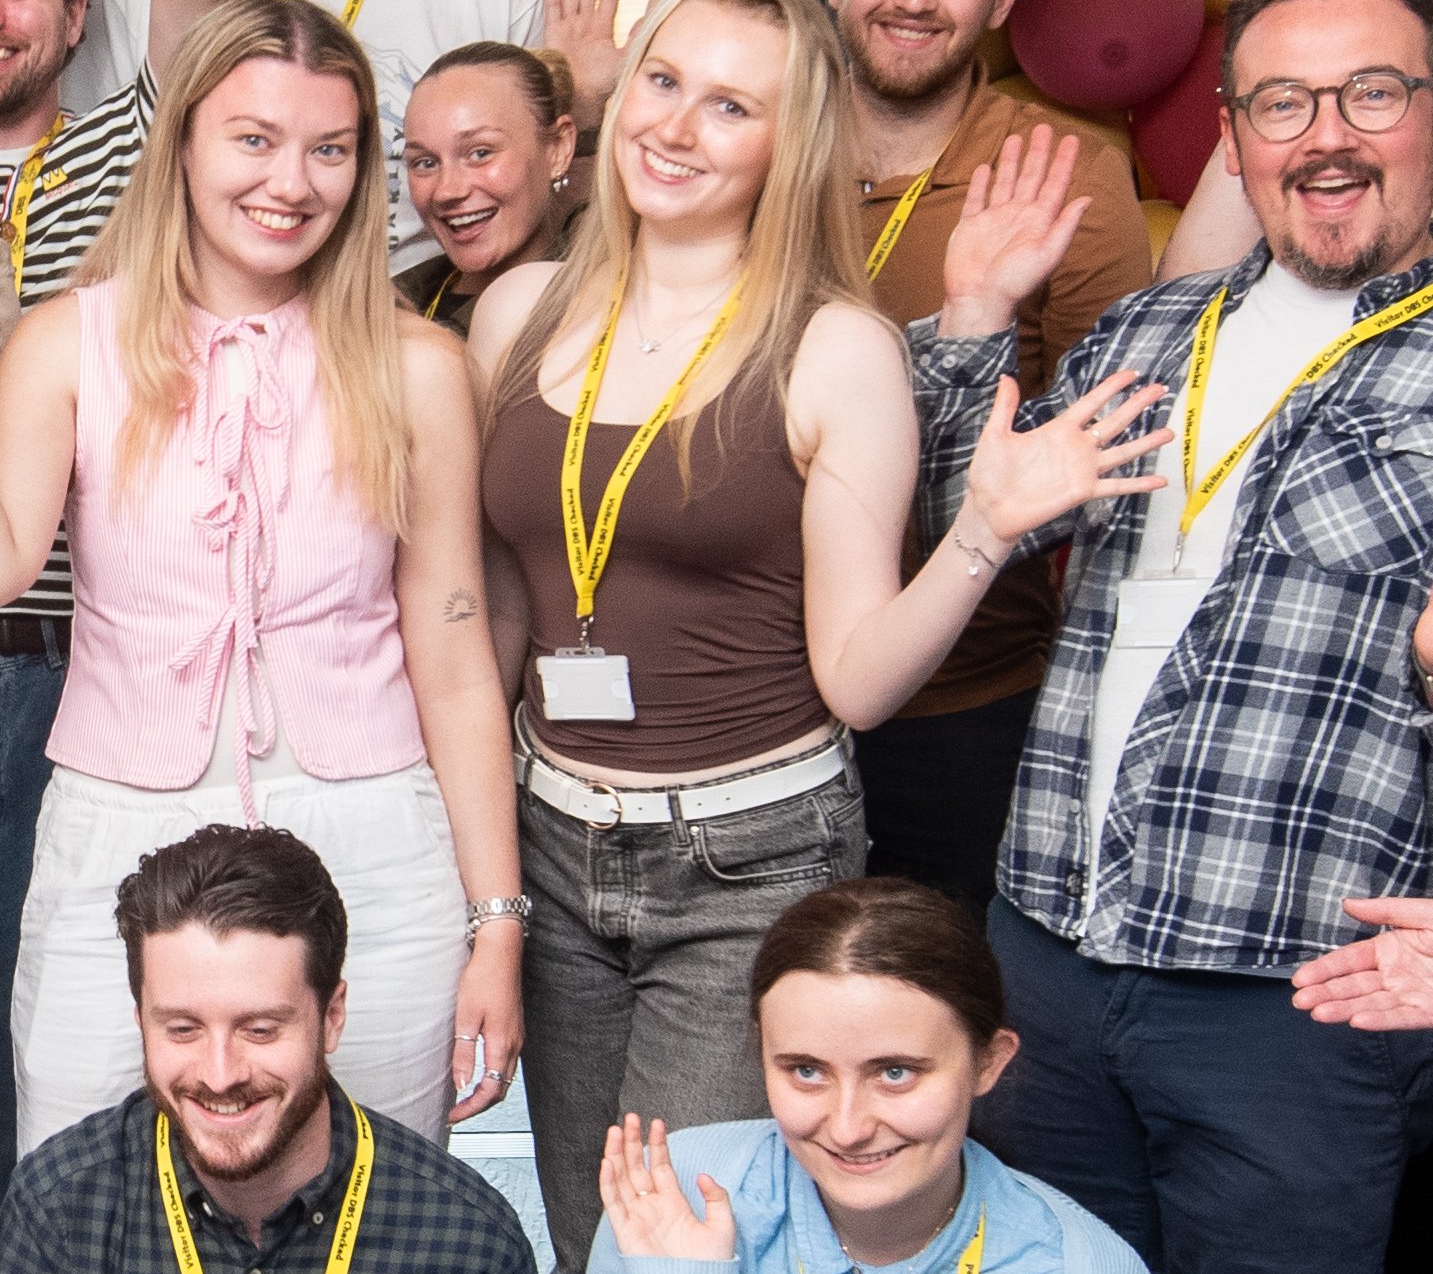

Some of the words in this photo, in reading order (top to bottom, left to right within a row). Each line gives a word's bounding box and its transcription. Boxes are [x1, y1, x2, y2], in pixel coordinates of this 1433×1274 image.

[15, 196, 27, 216] DBS
[1200, 313, 1213, 339] Visitor
[1373, 310, 1404, 328] Visitor
[1404, 300, 1422, 314] DBS
[1197, 339, 1207, 356] DBS
[1190, 357, 1205, 389] Checked
[162, 1170, 179, 1212] Checked
[351, 1164, 366, 1198] Visitor
[345, 1198, 358, 1218] DBS
[173, 1213, 185, 1233] DBS
[180, 1234, 195, 1270] Visitor
[334, 1220, 352, 1261] Checked
